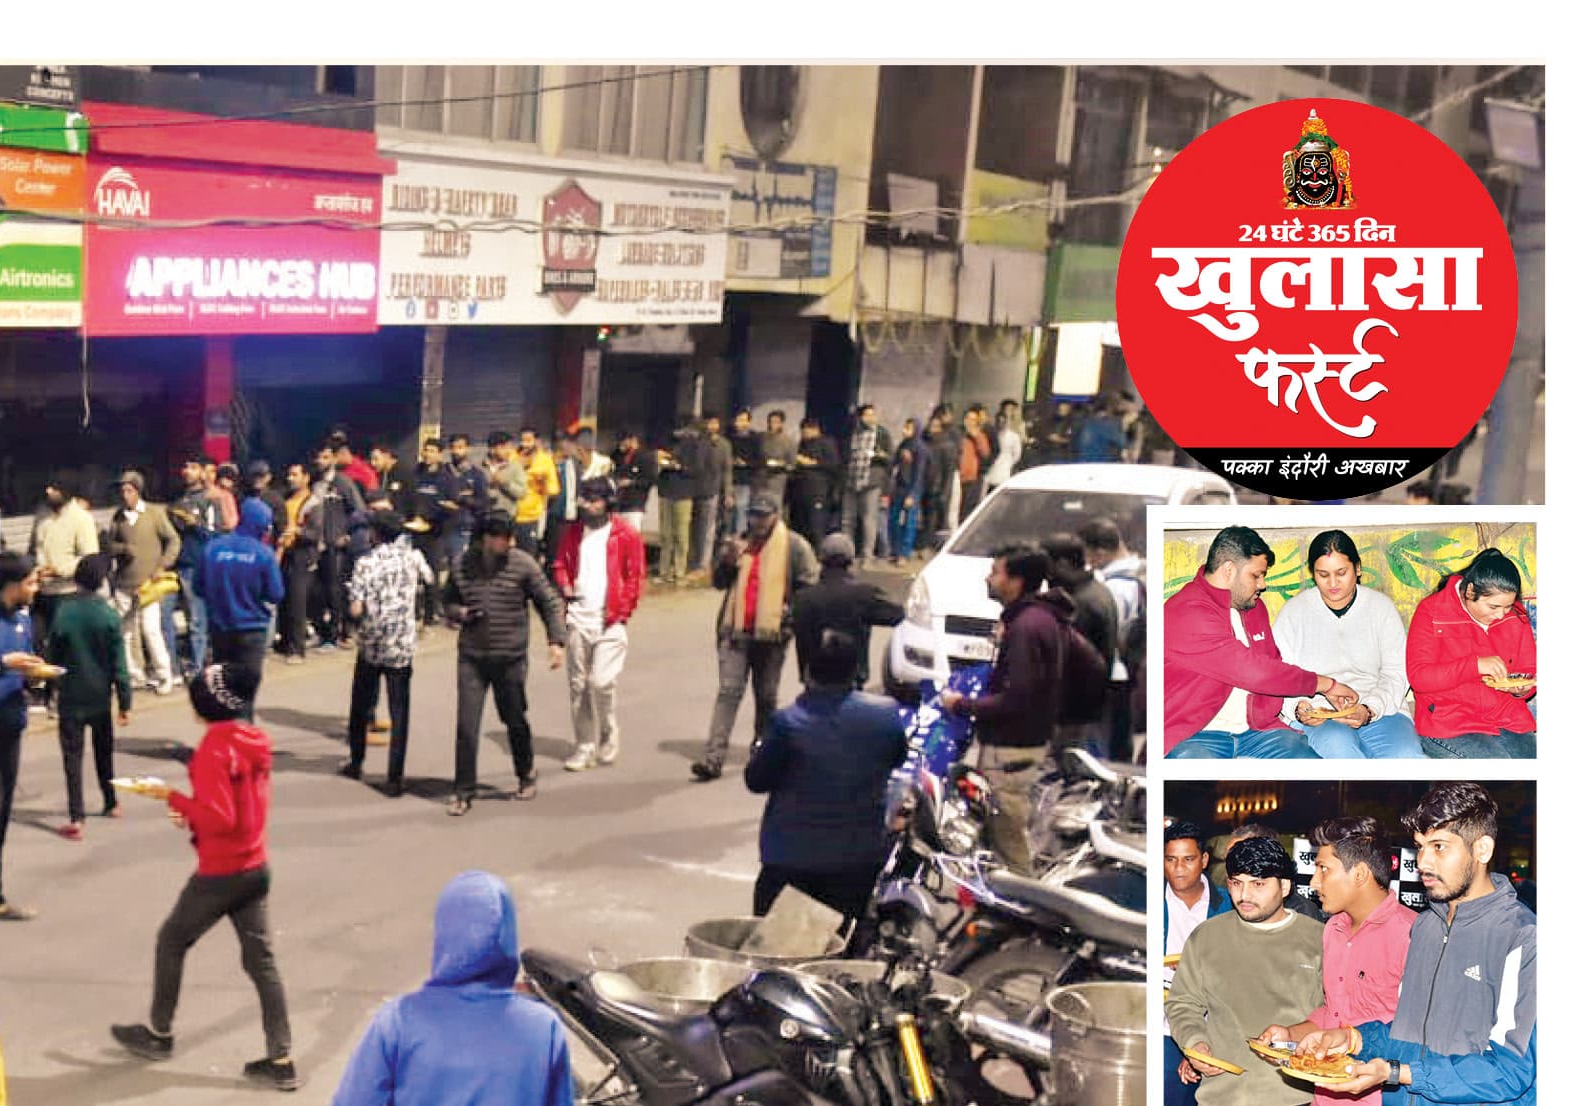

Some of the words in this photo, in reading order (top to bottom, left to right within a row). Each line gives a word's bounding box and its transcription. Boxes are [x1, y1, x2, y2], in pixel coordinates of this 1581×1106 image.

[34, 158, 73, 174] Power
[15, 180, 57, 195] Center
[126, 257, 316, 299] APPLIANCES
[319, 261, 377, 299] HUB
